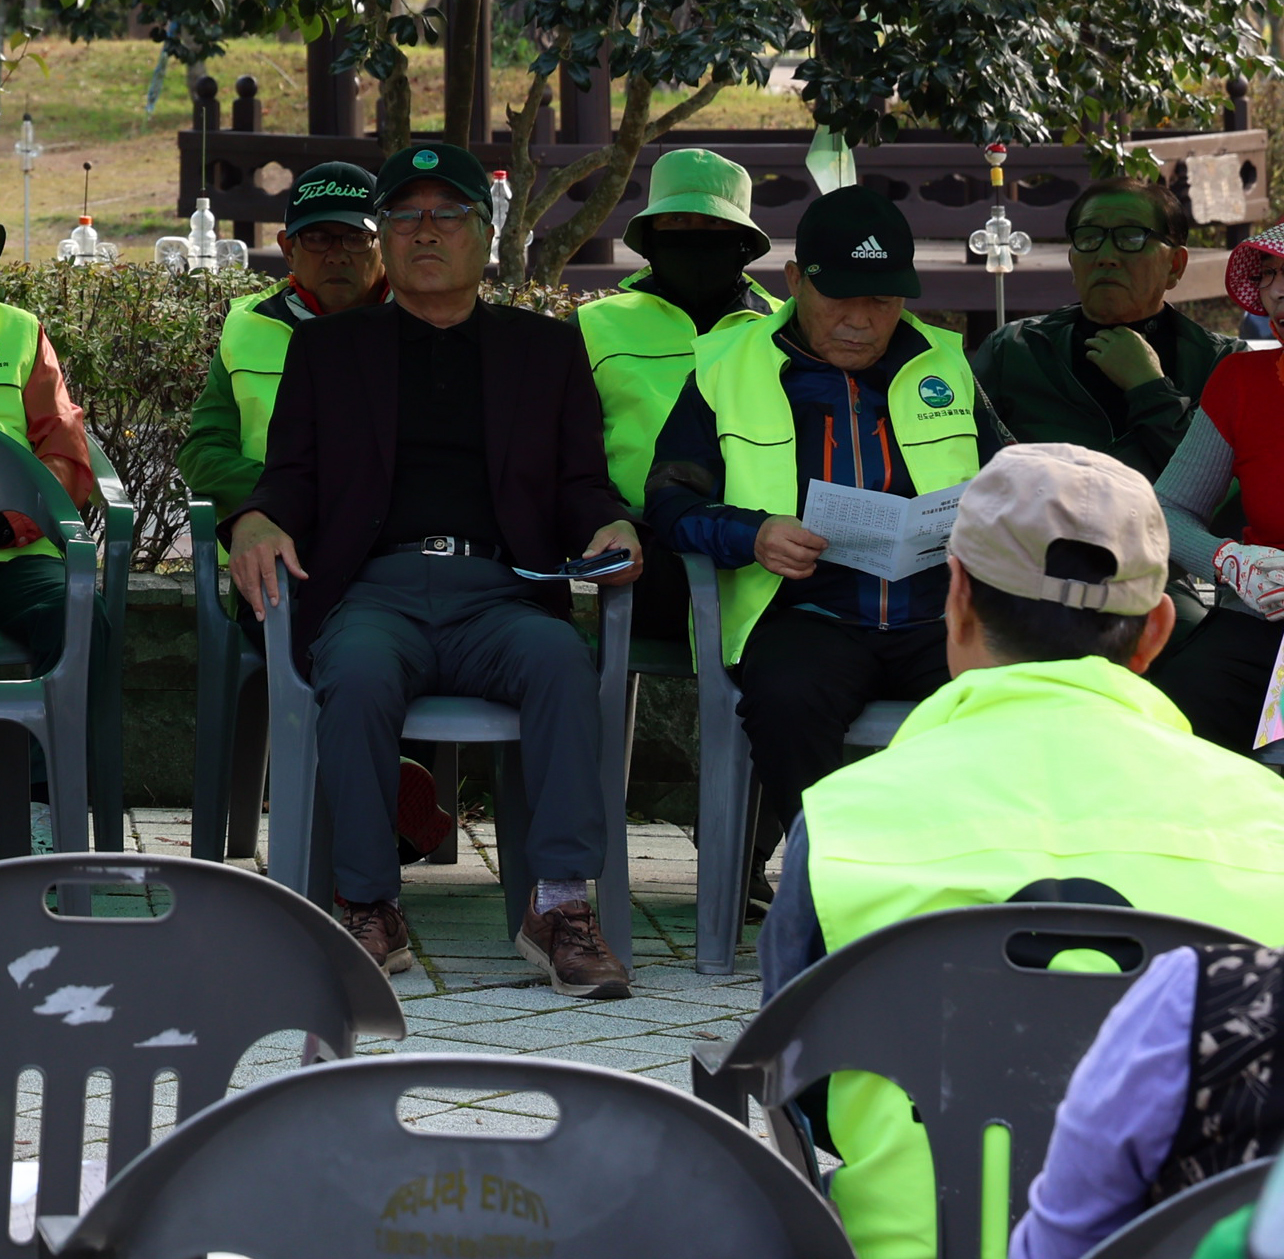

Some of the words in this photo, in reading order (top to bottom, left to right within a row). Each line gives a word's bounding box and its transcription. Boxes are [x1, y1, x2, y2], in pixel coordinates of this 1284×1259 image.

[293, 179, 370, 206] Titleist
[850, 250, 889, 259] adidas
[916, 408, 972, 421] 진도군파크골프협회
